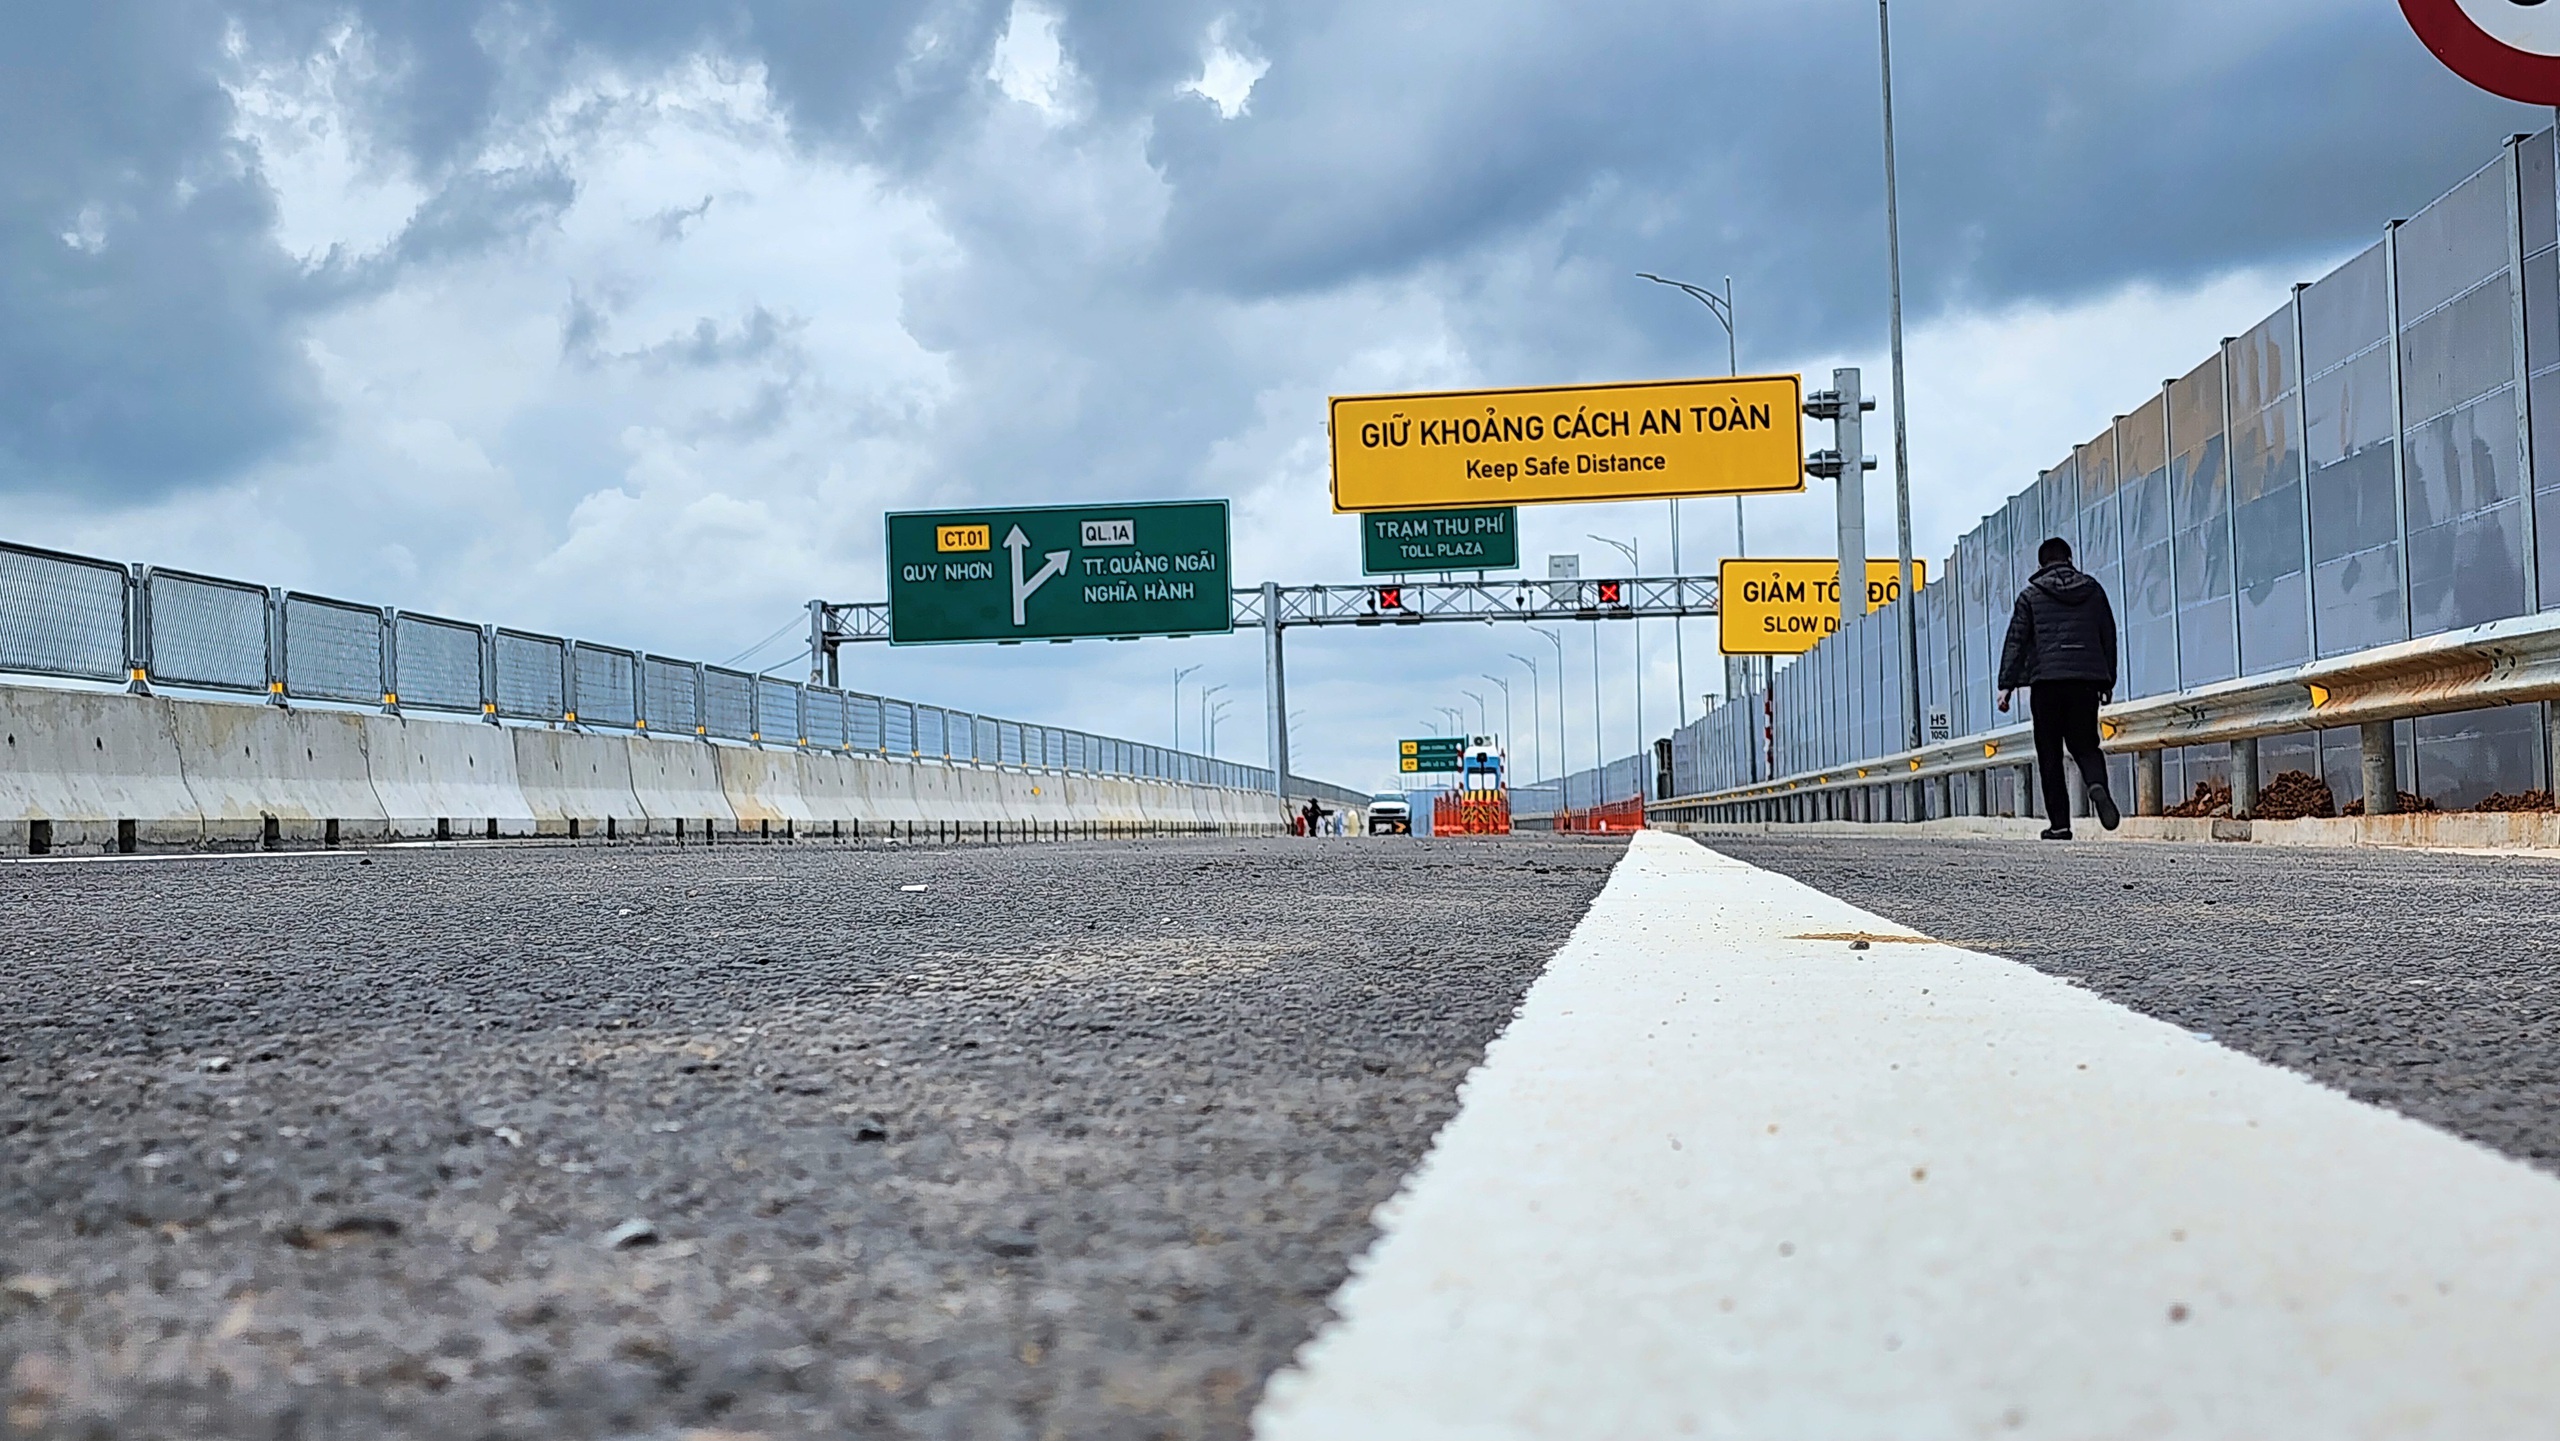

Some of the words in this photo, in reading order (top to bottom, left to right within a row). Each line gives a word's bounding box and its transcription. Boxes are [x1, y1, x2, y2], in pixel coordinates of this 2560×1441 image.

[1361, 412, 1412, 448] GIỮ
[1420, 407, 1544, 446] KHOẢNG
[1553, 405, 1629, 440] CÁCH
[1639, 408, 1681, 436] AN
[1690, 397, 1771, 433] TOÀN
[1466, 459, 1519, 482] Keep
[1524, 456, 1570, 476] Safe
[1577, 454, 1666, 474] Distance
[1085, 525, 1130, 542] QL.1A
[1375, 520, 1428, 541] TRẠM
[1433, 518, 1470, 535] THU
[1474, 512, 1505, 535] PHÍ
[944, 530, 983, 547] CT.01
[1400, 544, 1434, 558] TOLL
[1437, 542, 1484, 557] PLAZA
[903, 564, 938, 581] QUY
[944, 561, 993, 580] NHƠN
[1175, 550, 1216, 572] NGÃI
[1084, 580, 1138, 603] NGHĨA
[1144, 579, 1195, 601] HÀNH
[1743, 572, 1805, 603] GIẢM
[1763, 615, 1818, 633] SLOW
[1930, 714, 1947, 726] H5
[1931, 730, 1949, 740] 1050
